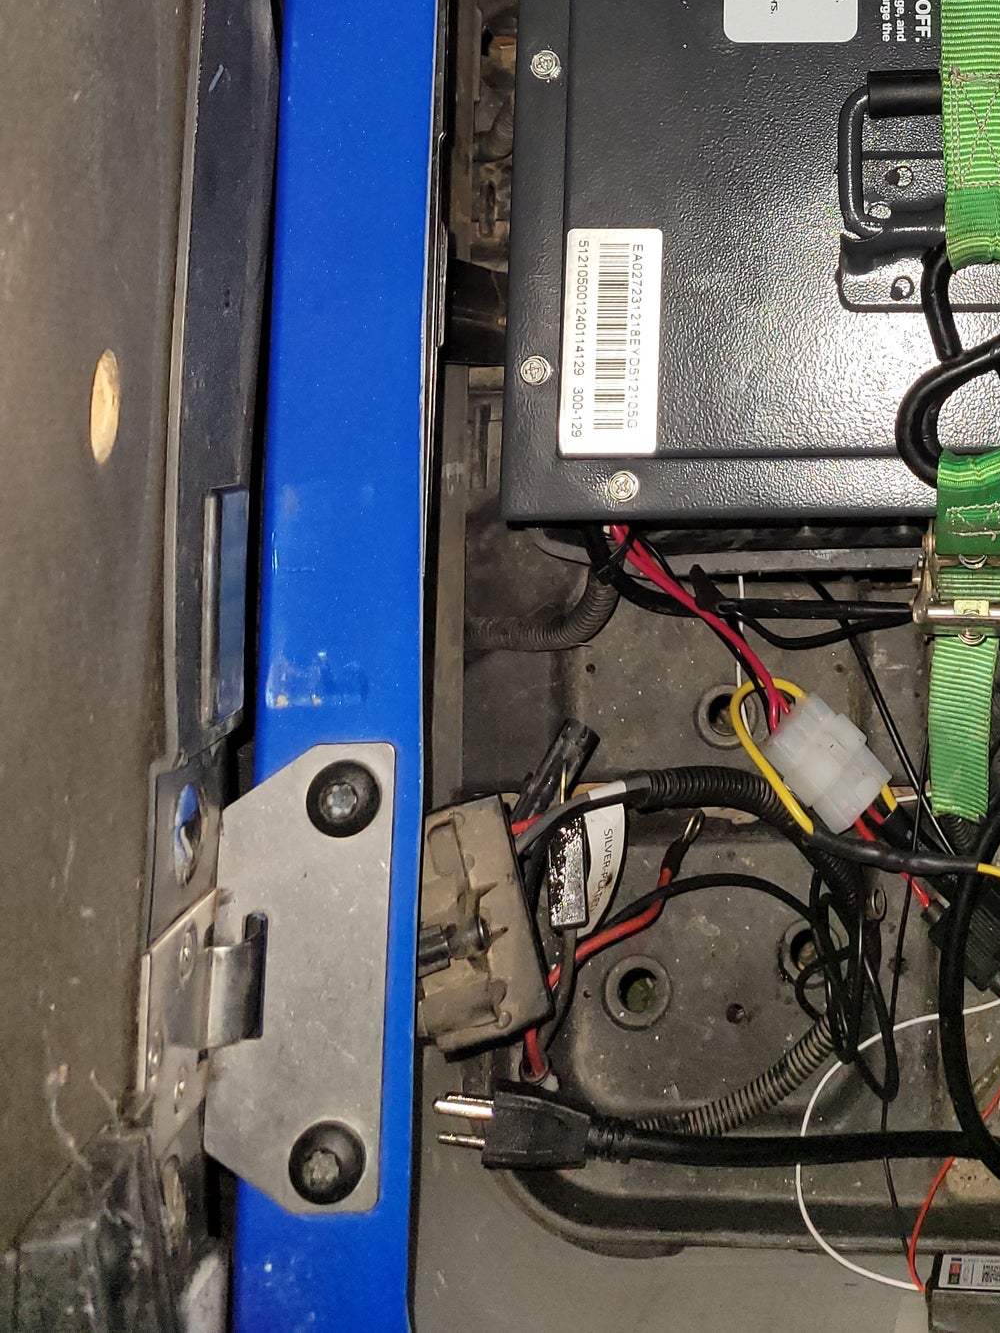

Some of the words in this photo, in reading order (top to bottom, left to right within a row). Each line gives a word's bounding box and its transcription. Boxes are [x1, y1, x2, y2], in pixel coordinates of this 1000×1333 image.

[883, 23, 892, 41] the
[897, 20, 907, 41] and
[916, 0, 931, 41] OFF.
[574, 240, 589, 375] 512105001240114129
[572, 388, 584, 436] 300-129
